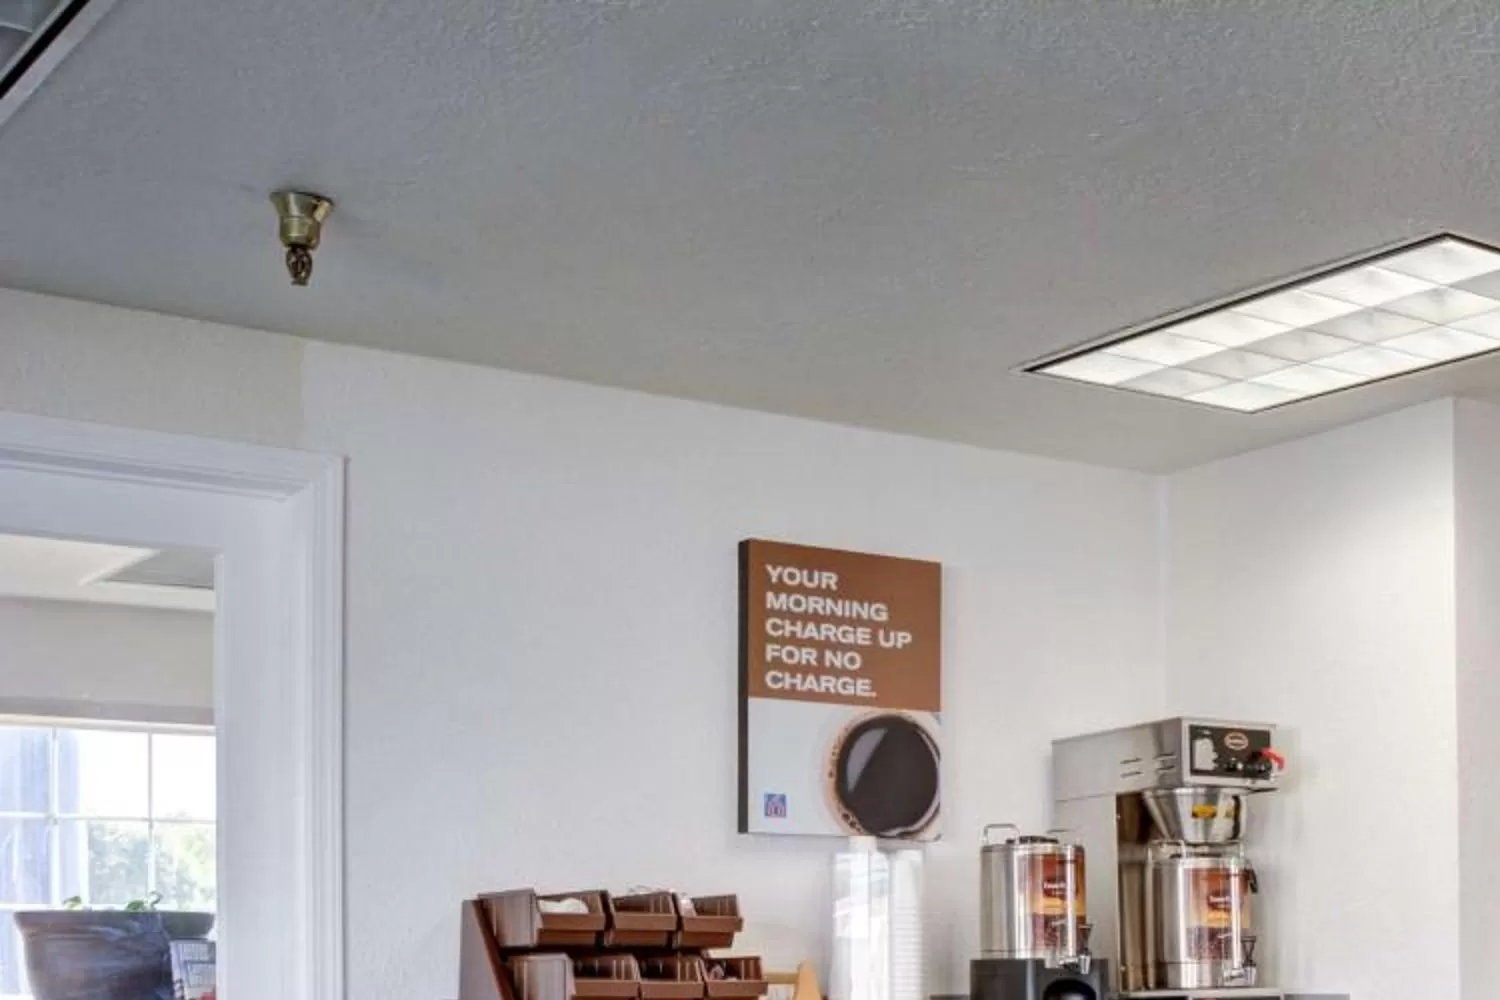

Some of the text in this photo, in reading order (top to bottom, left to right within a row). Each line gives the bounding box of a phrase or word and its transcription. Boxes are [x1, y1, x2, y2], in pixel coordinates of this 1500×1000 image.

[765, 564, 838, 591] YOUR
[765, 591, 888, 622] MORNING
[765, 617, 912, 649] CHARGE UP
[765, 644, 861, 671] FOR NO
[765, 670, 877, 697] CHARGE.
